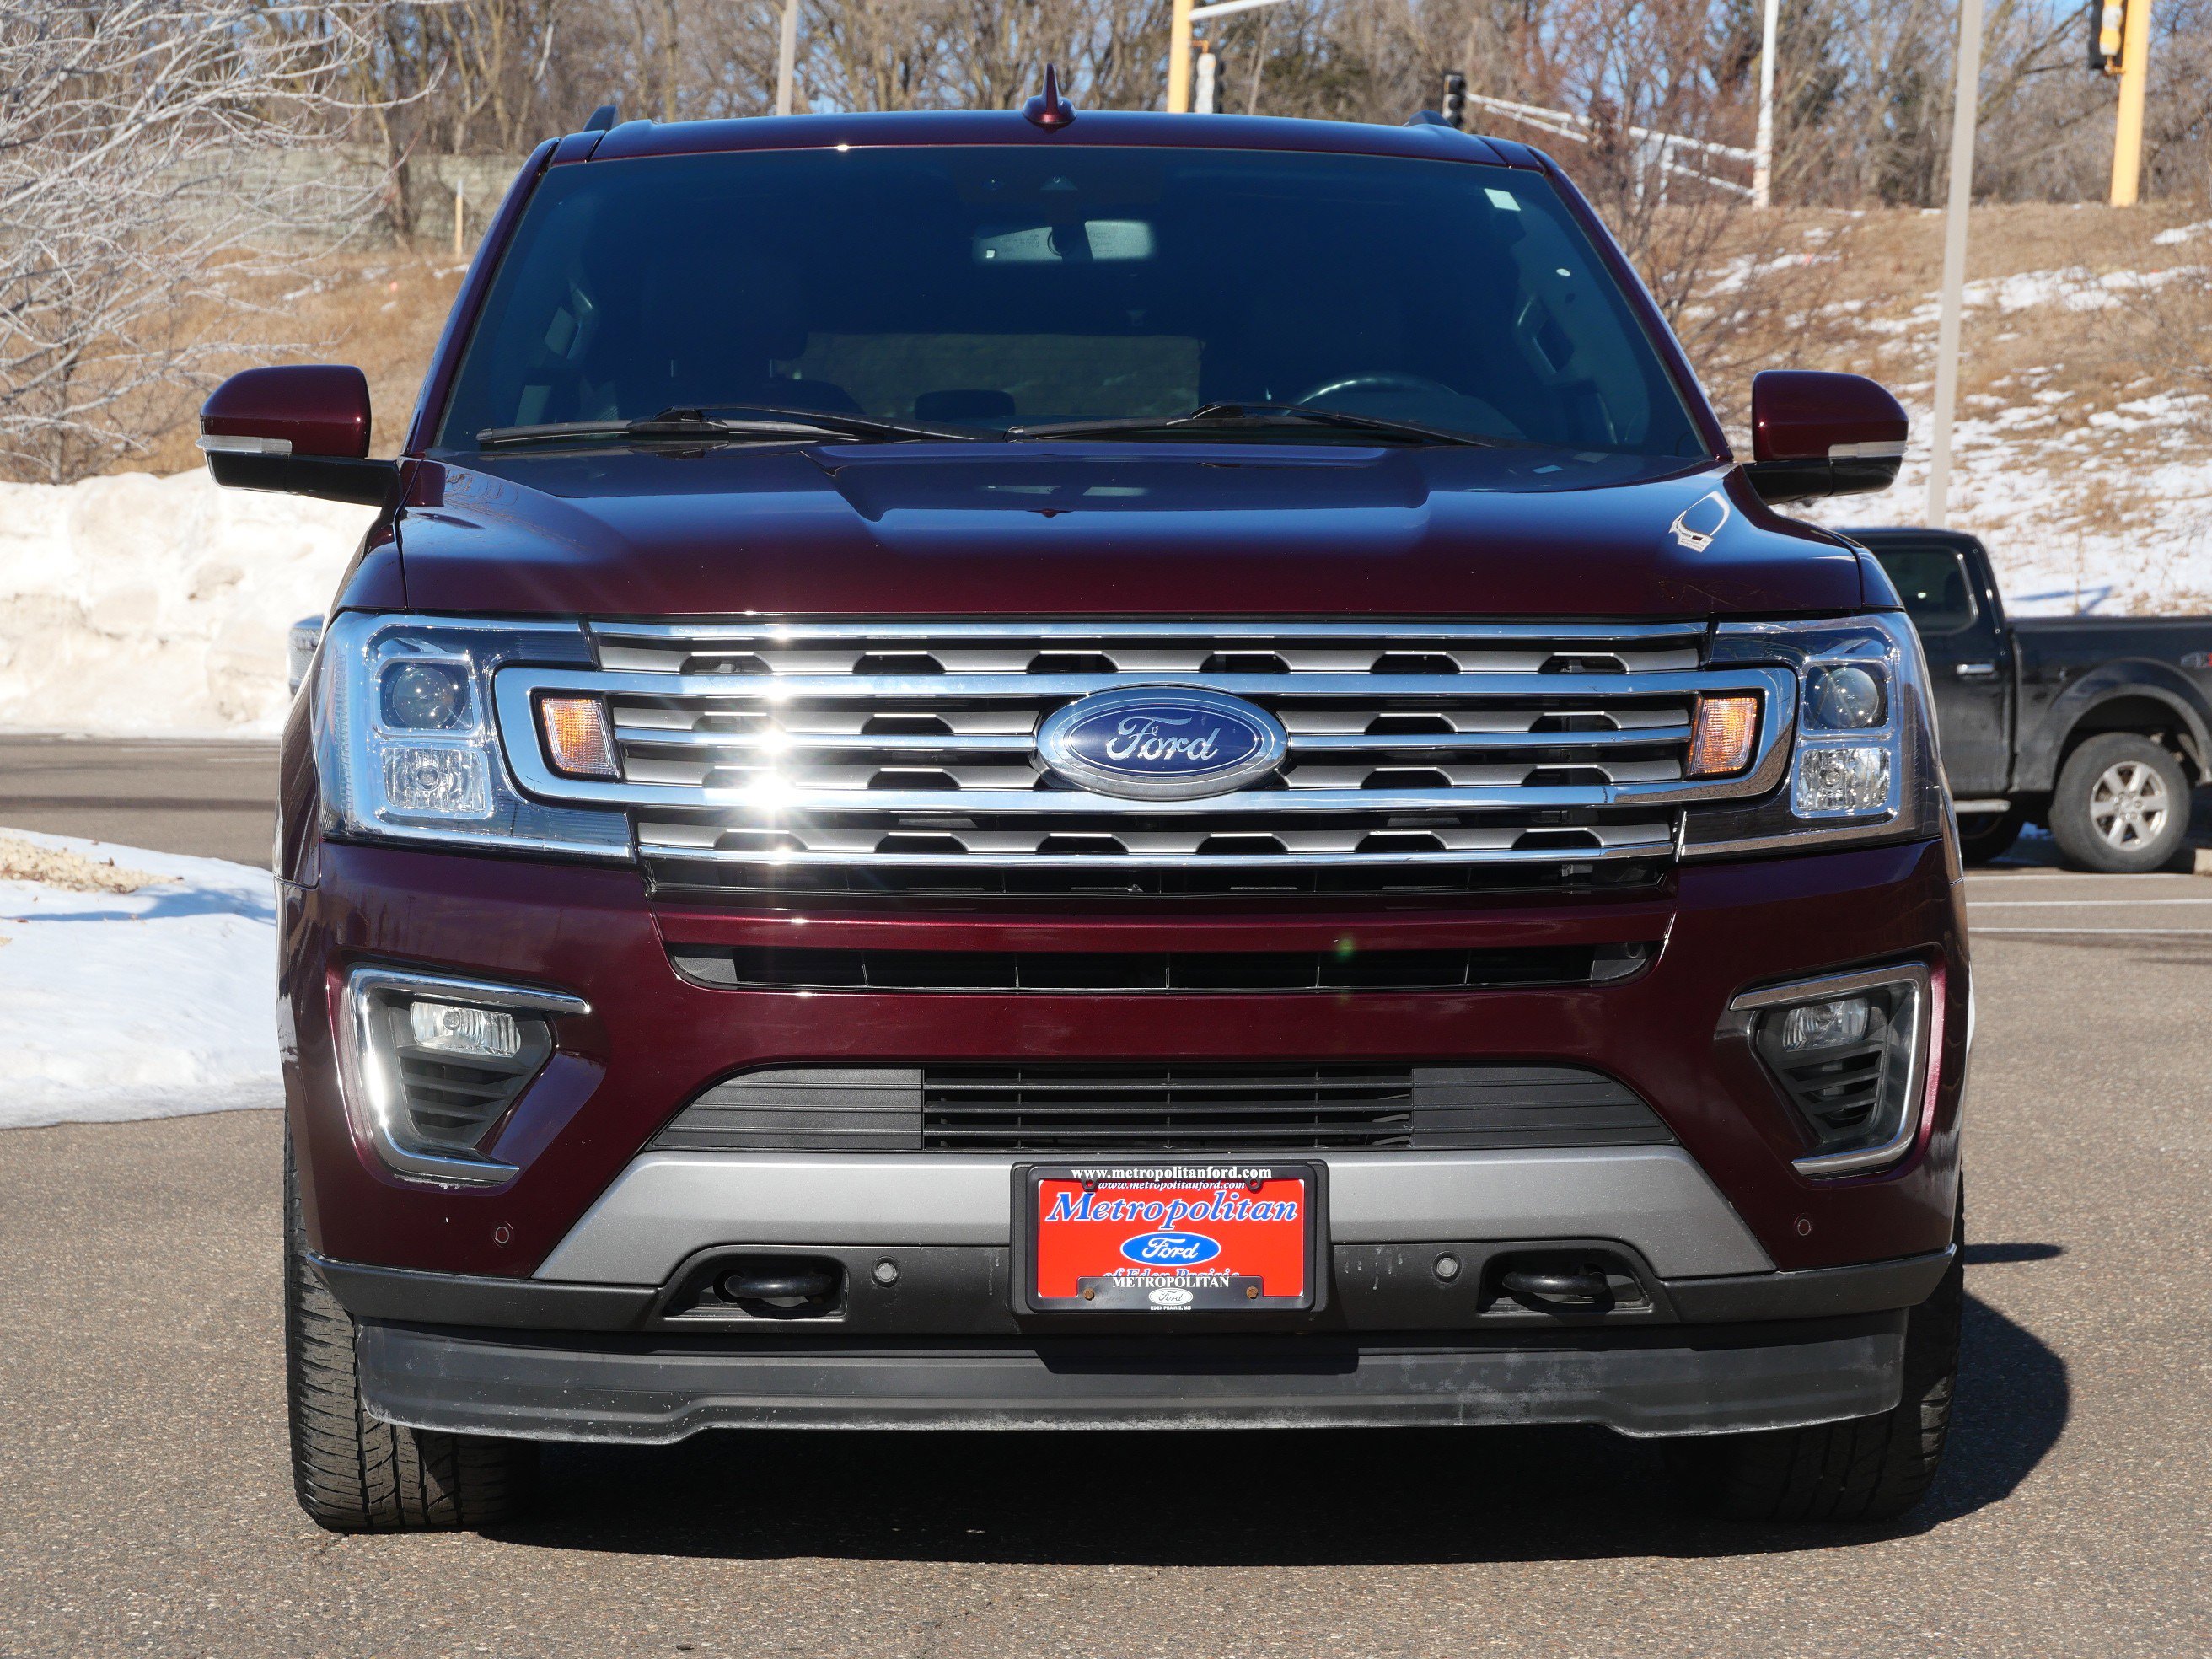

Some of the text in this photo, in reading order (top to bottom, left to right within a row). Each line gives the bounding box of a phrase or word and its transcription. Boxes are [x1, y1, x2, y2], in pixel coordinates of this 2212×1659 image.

[1105, 716, 1221, 760] Ford
[1071, 1166, 1272, 1182] www.metropolitanford.com
[1098, 1180, 1246, 1192] www.metropolitanford.com
[1045, 1189, 1297, 1231] Metropolitan
[1141, 1237, 1200, 1259] Ford
[1112, 1276, 1230, 1288] METROPOLITAN
[1158, 1290, 1184, 1302] Ford
